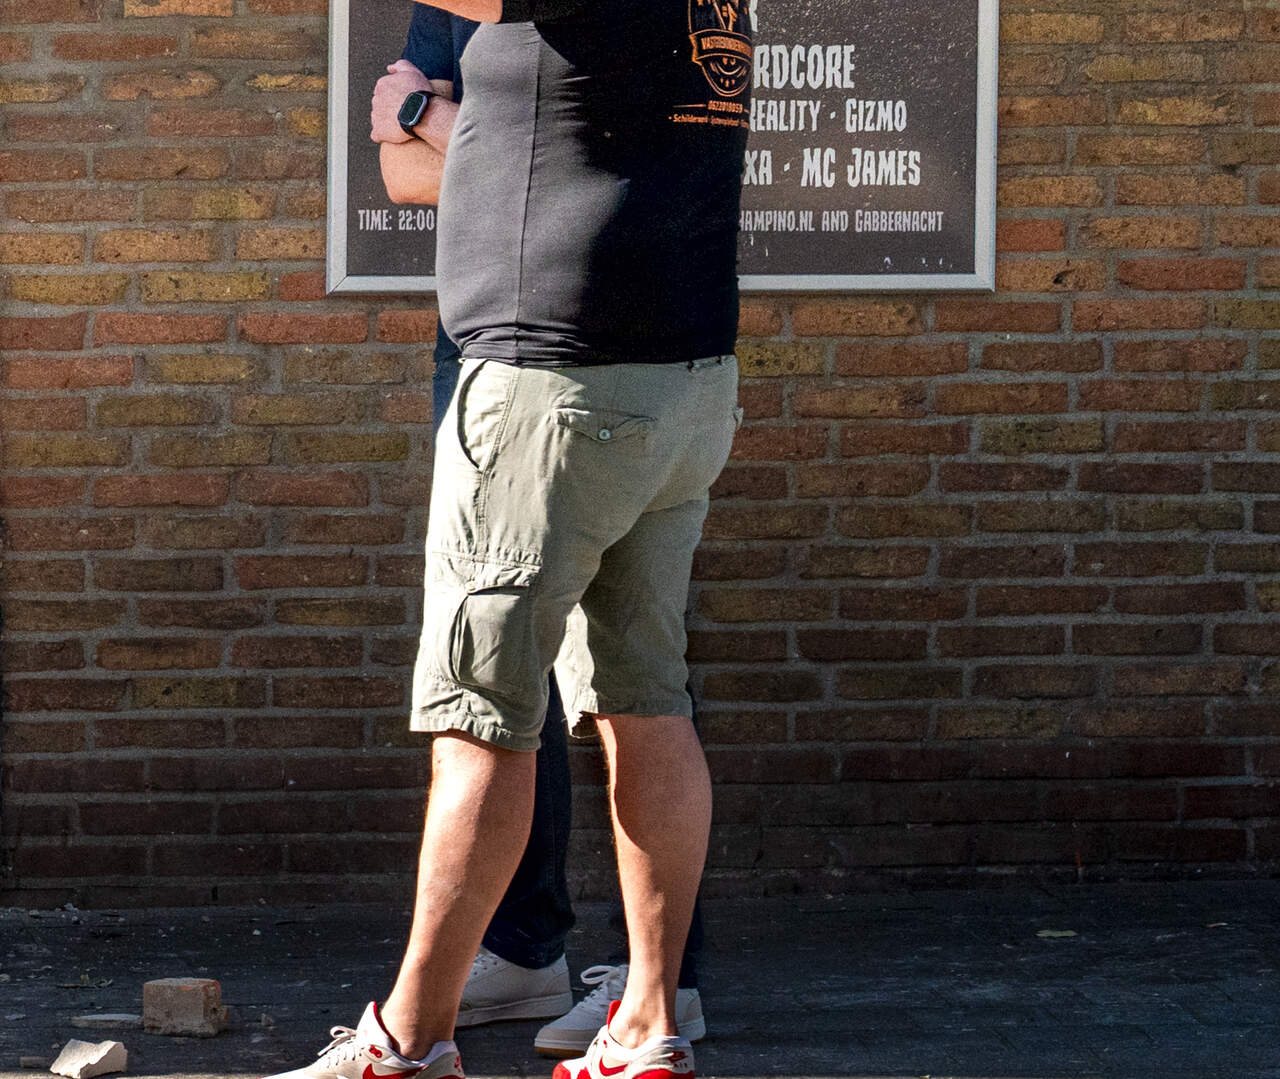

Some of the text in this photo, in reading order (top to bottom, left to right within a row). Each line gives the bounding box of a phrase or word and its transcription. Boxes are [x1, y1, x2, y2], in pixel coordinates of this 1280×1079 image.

[753, 44, 855, 89] RDCORE
[845, 98, 908, 133] GIZMO
[801, 148, 836, 188] MC
[847, 148, 921, 188] JAMES
[358, 209, 944, 232] TIME: 22:00 HAMPINO.NL AND GABBERNACHT
